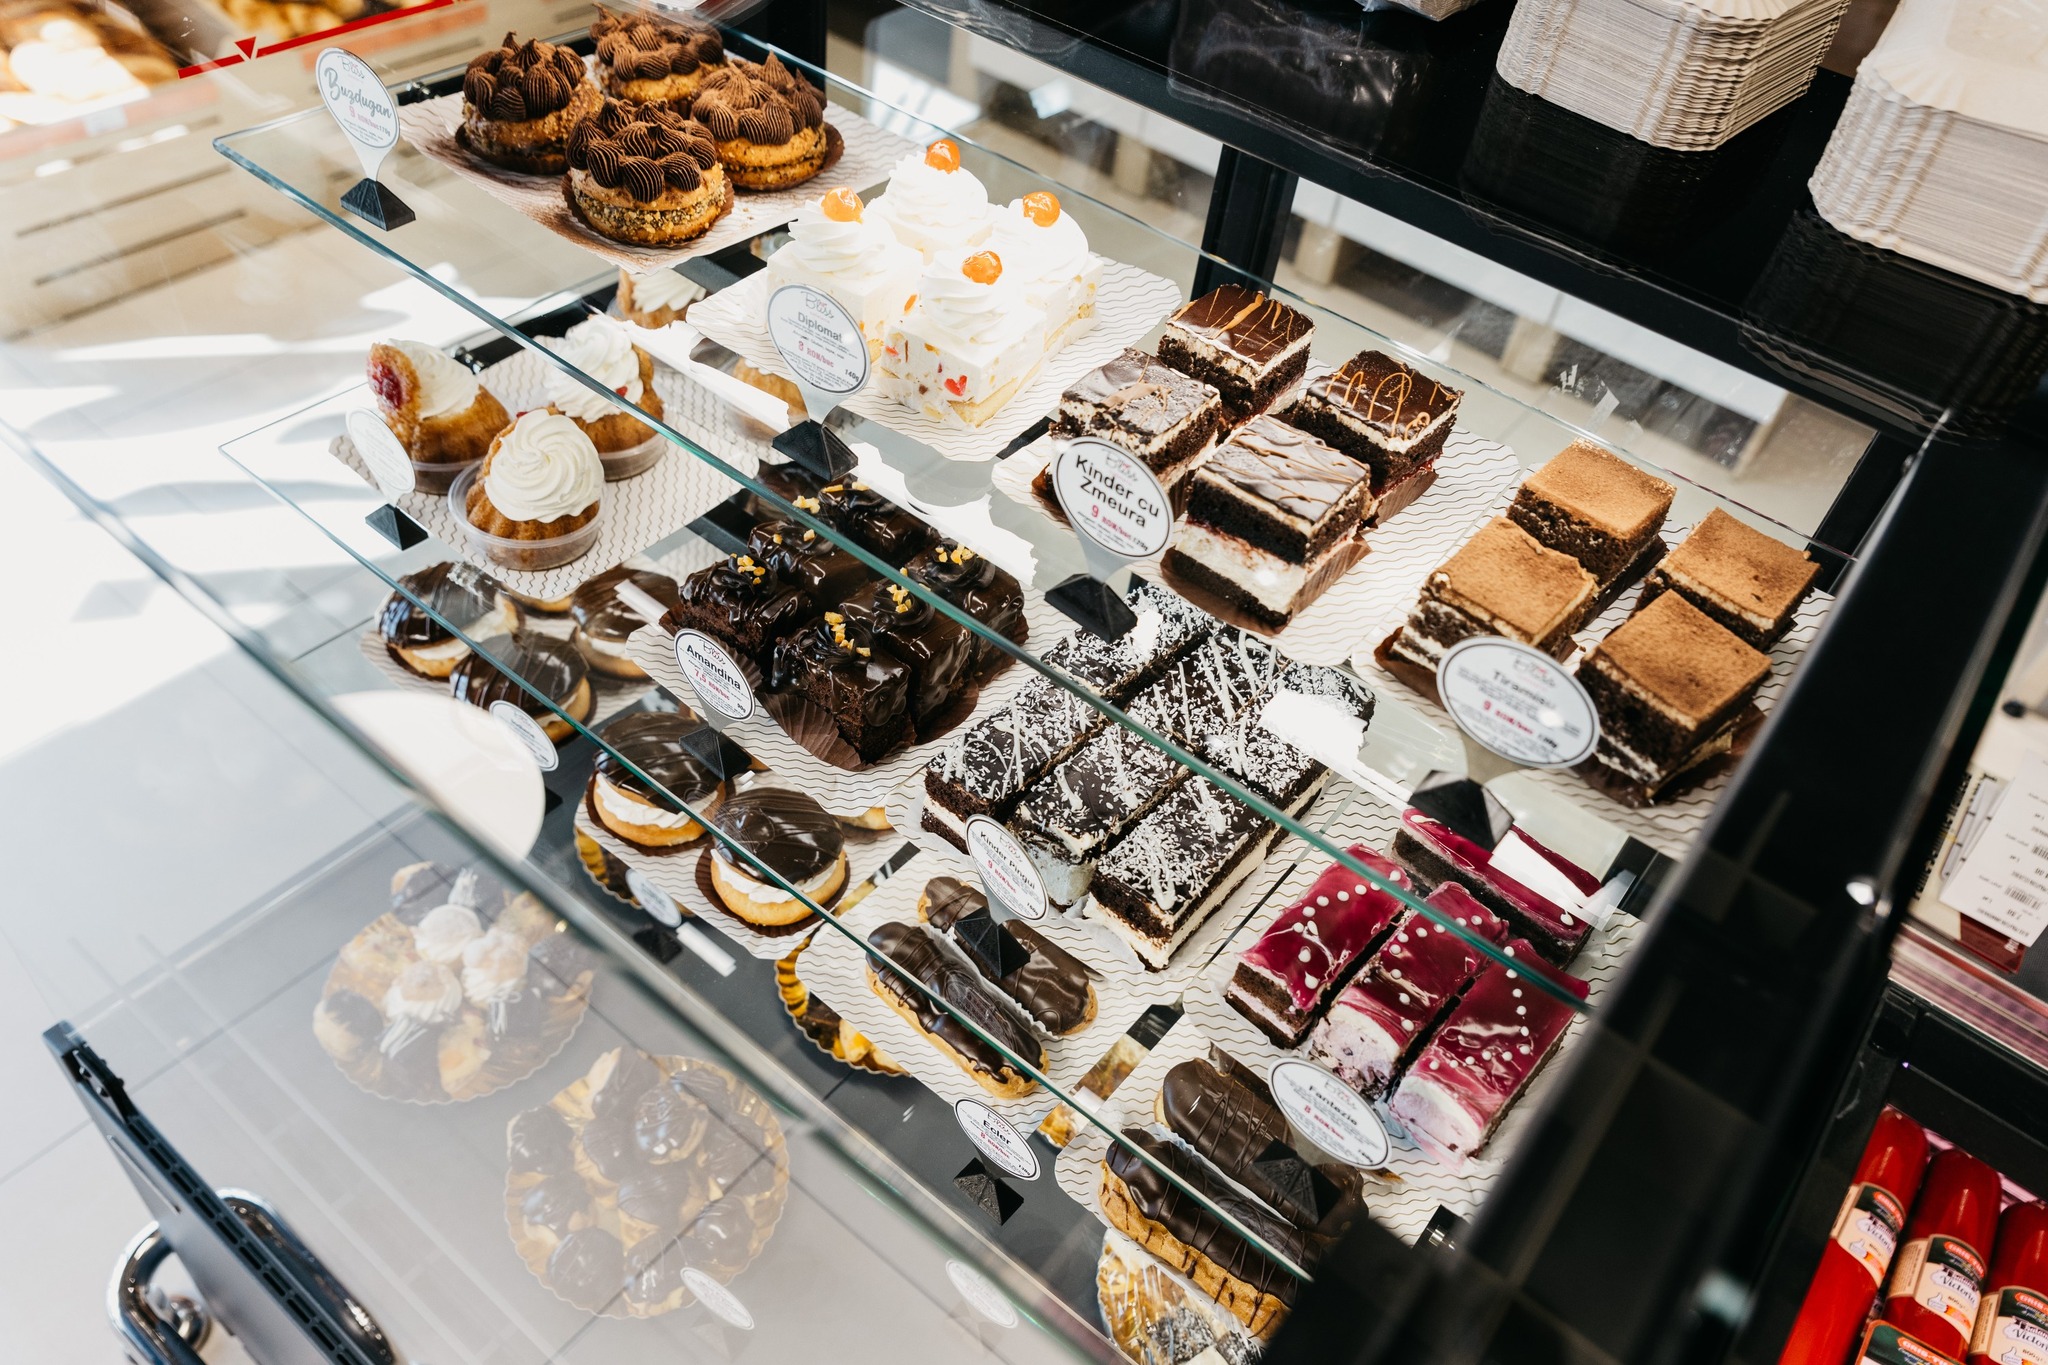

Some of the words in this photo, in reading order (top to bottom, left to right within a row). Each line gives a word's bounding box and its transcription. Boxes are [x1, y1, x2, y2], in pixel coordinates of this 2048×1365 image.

[324, 67, 392, 119] Buzdugan
[797, 311, 843, 341] Diplomat
[1075, 454, 1134, 499] Kinder
[1137, 498, 1160, 518] cu
[1079, 475, 1147, 528] Zmeura
[1091, 504, 1100, 518] 9
[686, 644, 741, 691] Amandina
[1482, 699, 1492, 711] 9
[980, 831, 1007, 861] Kinder
[1008, 859, 1036, 890] Pingui
[1308, 1084, 1358, 1126] Fantezia
[983, 1119, 1012, 1145] Ecler
